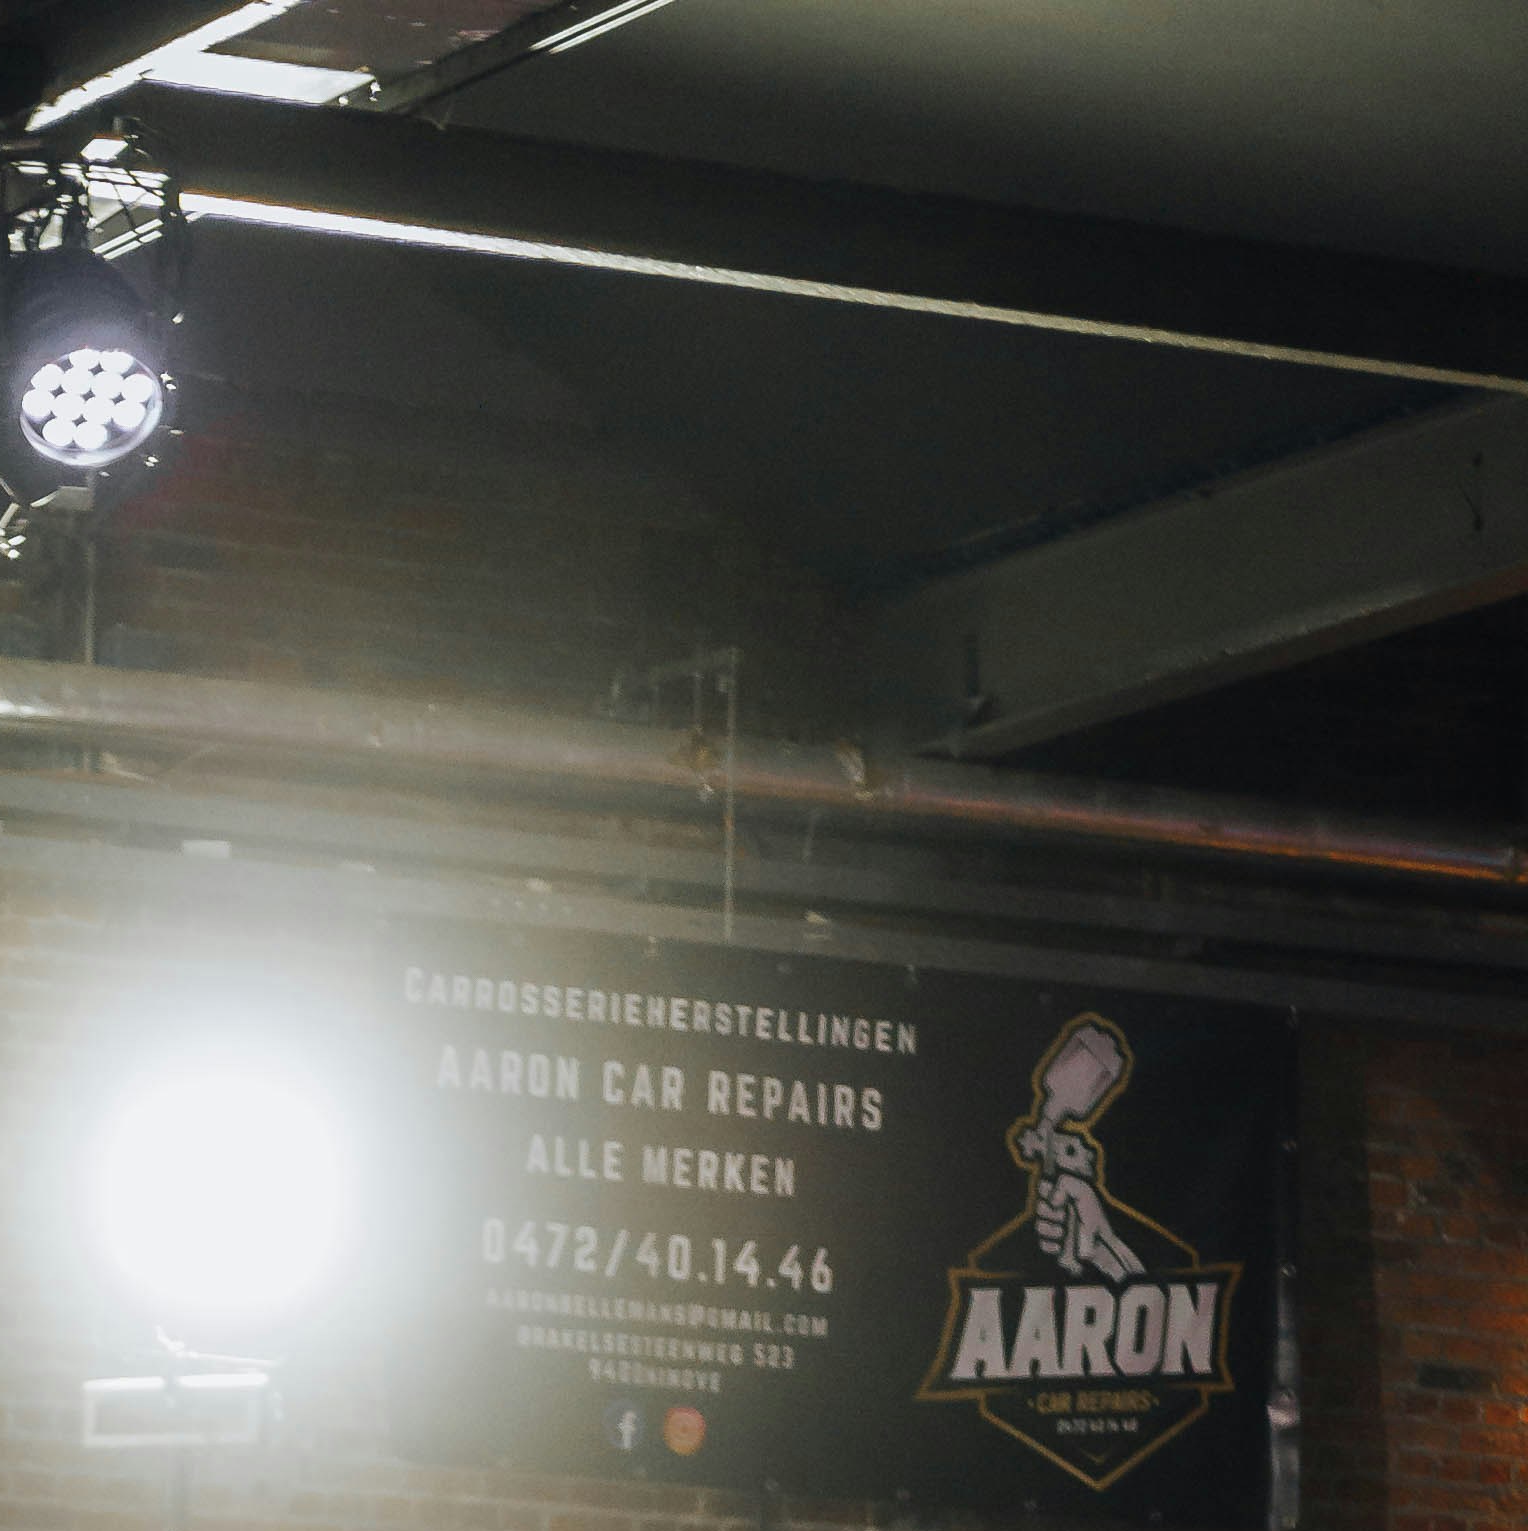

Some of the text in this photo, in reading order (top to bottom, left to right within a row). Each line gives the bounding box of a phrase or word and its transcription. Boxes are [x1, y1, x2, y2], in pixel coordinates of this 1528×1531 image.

[404, 966, 918, 1056] CARROSSERIEHERSTELLINGEN
[436, 1045, 884, 1131] AARON CAR REPAIRS
[526, 1133, 798, 1198] ALLE MERKEN
[481, 1217, 835, 1294] 0472/40.14.46
[949, 1282, 1219, 1379] AARON
